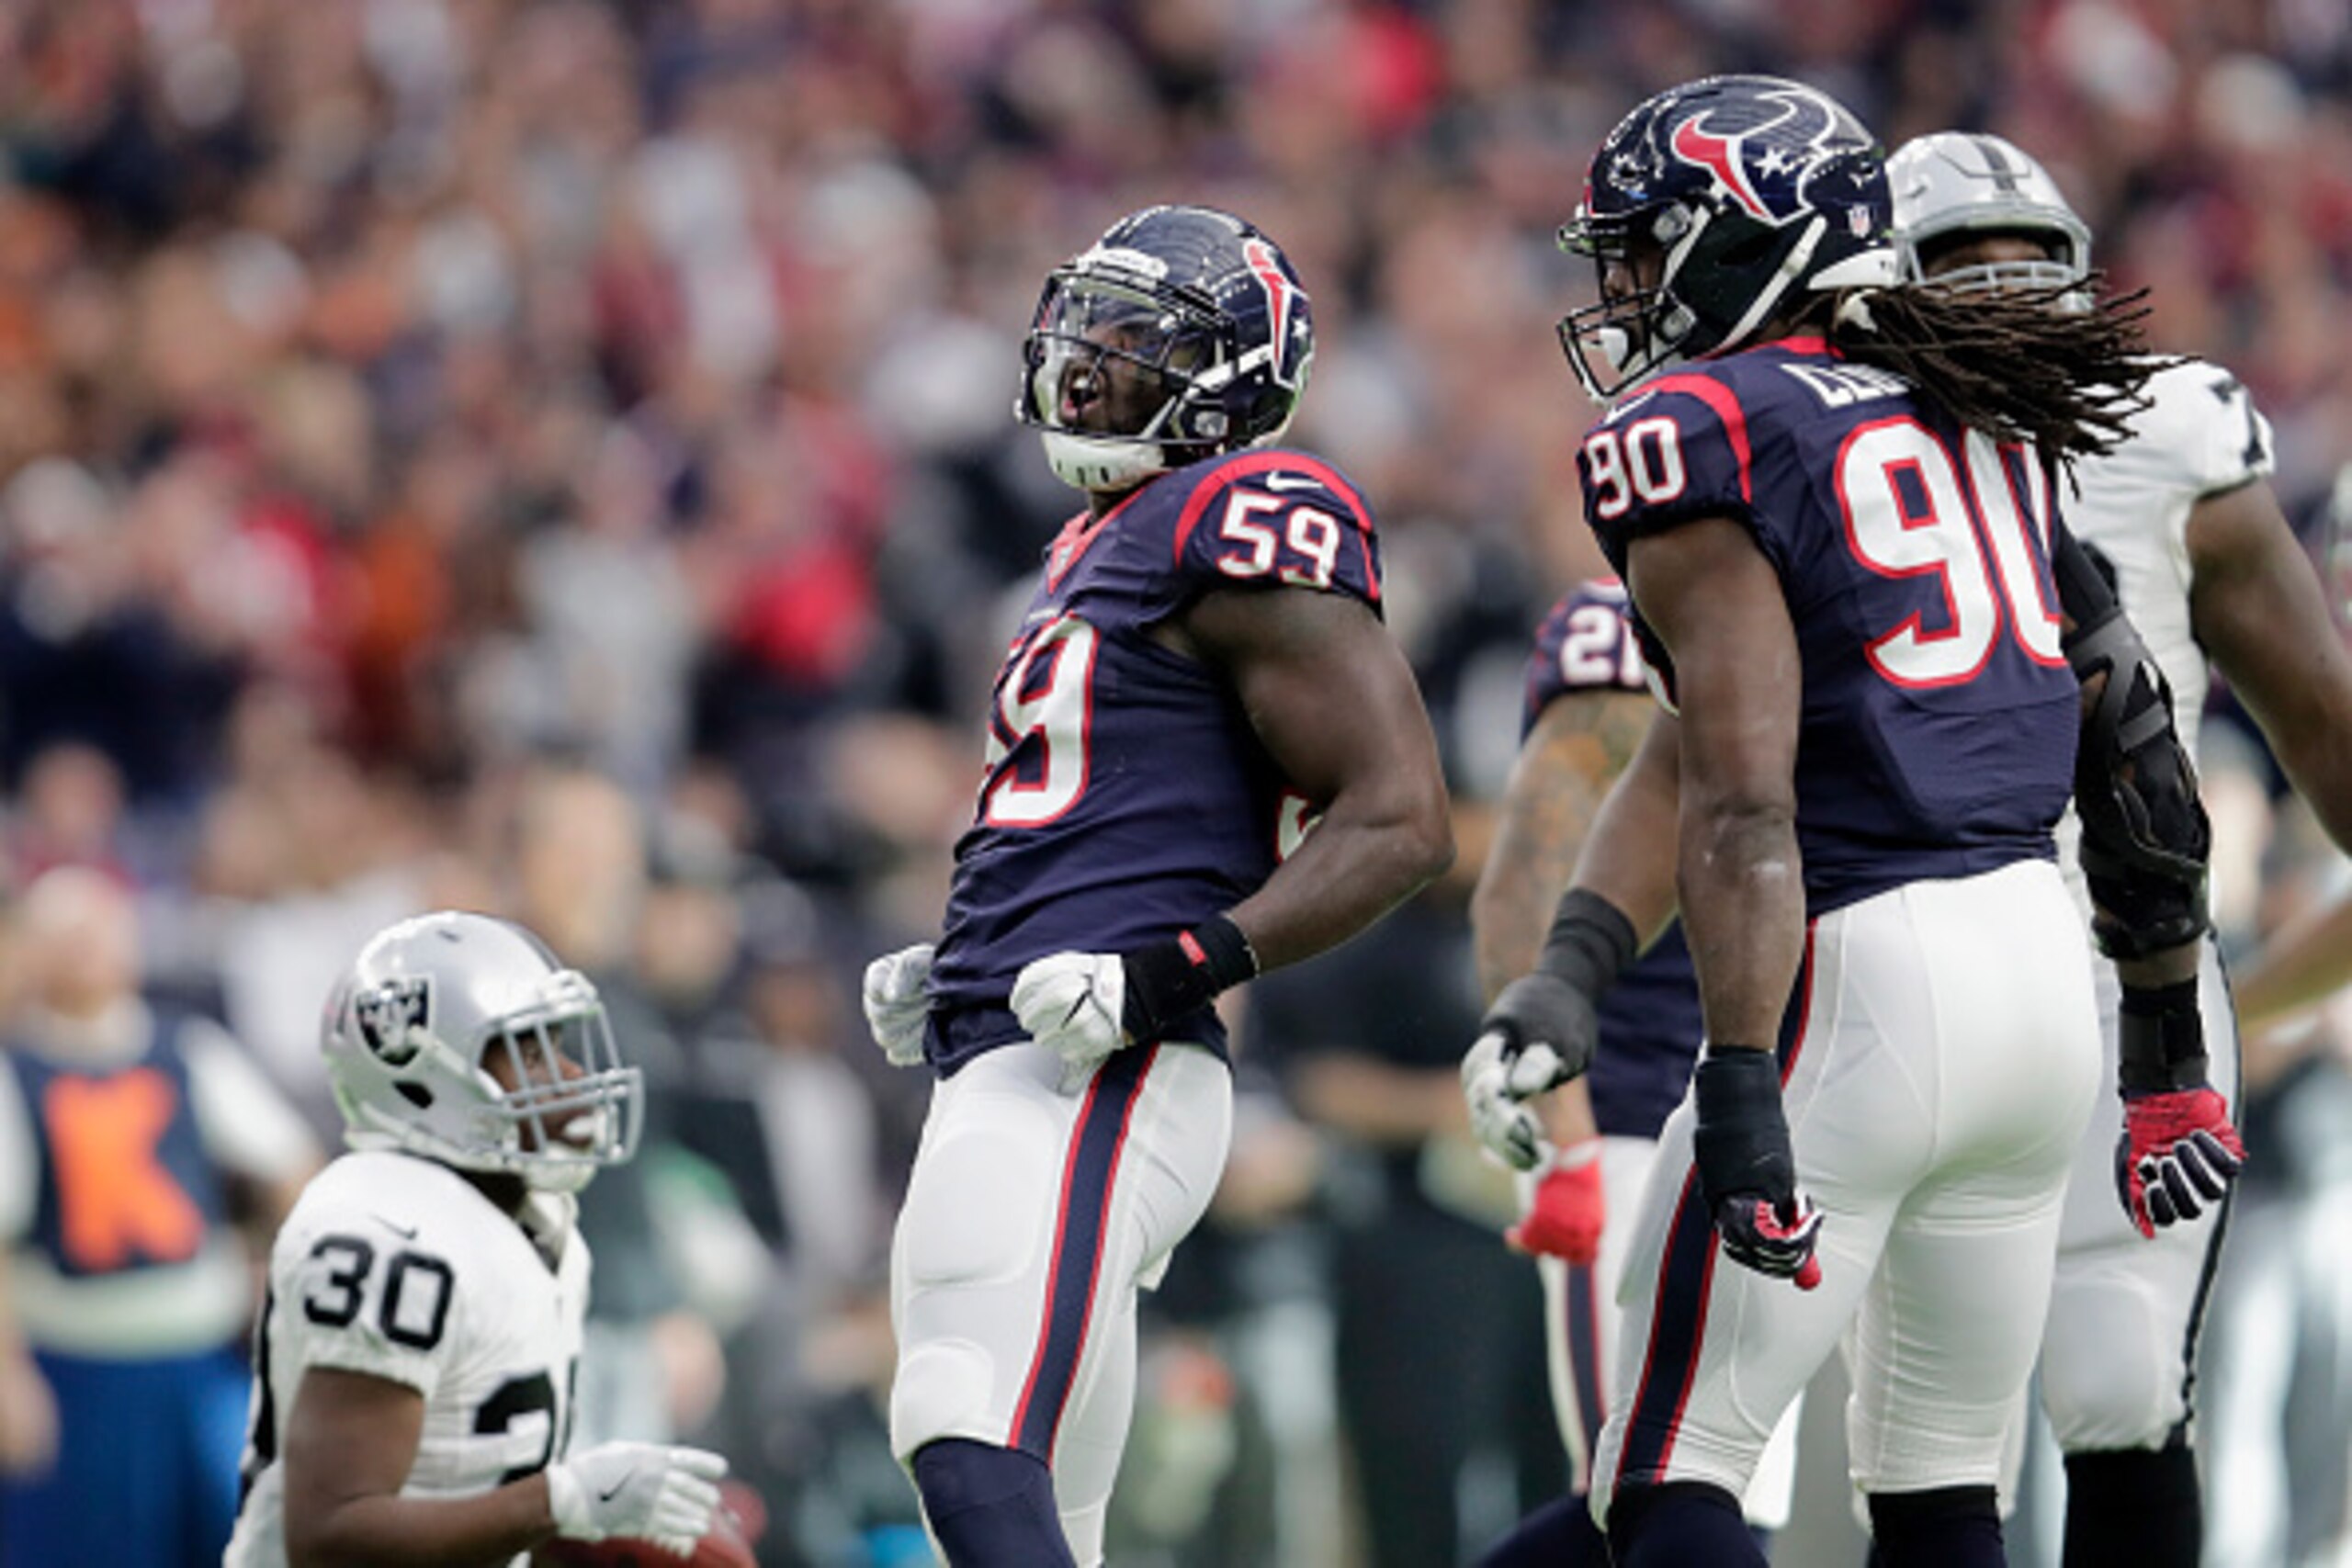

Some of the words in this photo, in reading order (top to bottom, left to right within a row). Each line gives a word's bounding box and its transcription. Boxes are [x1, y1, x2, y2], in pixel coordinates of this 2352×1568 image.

[1216, 487, 1340, 590] 59
[1583, 415, 1688, 520] 90
[1833, 413, 2070, 689] 90
[975, 610, 1101, 828] 9
[42, 1066, 205, 1275] K
[301, 1231, 456, 1353] 30
